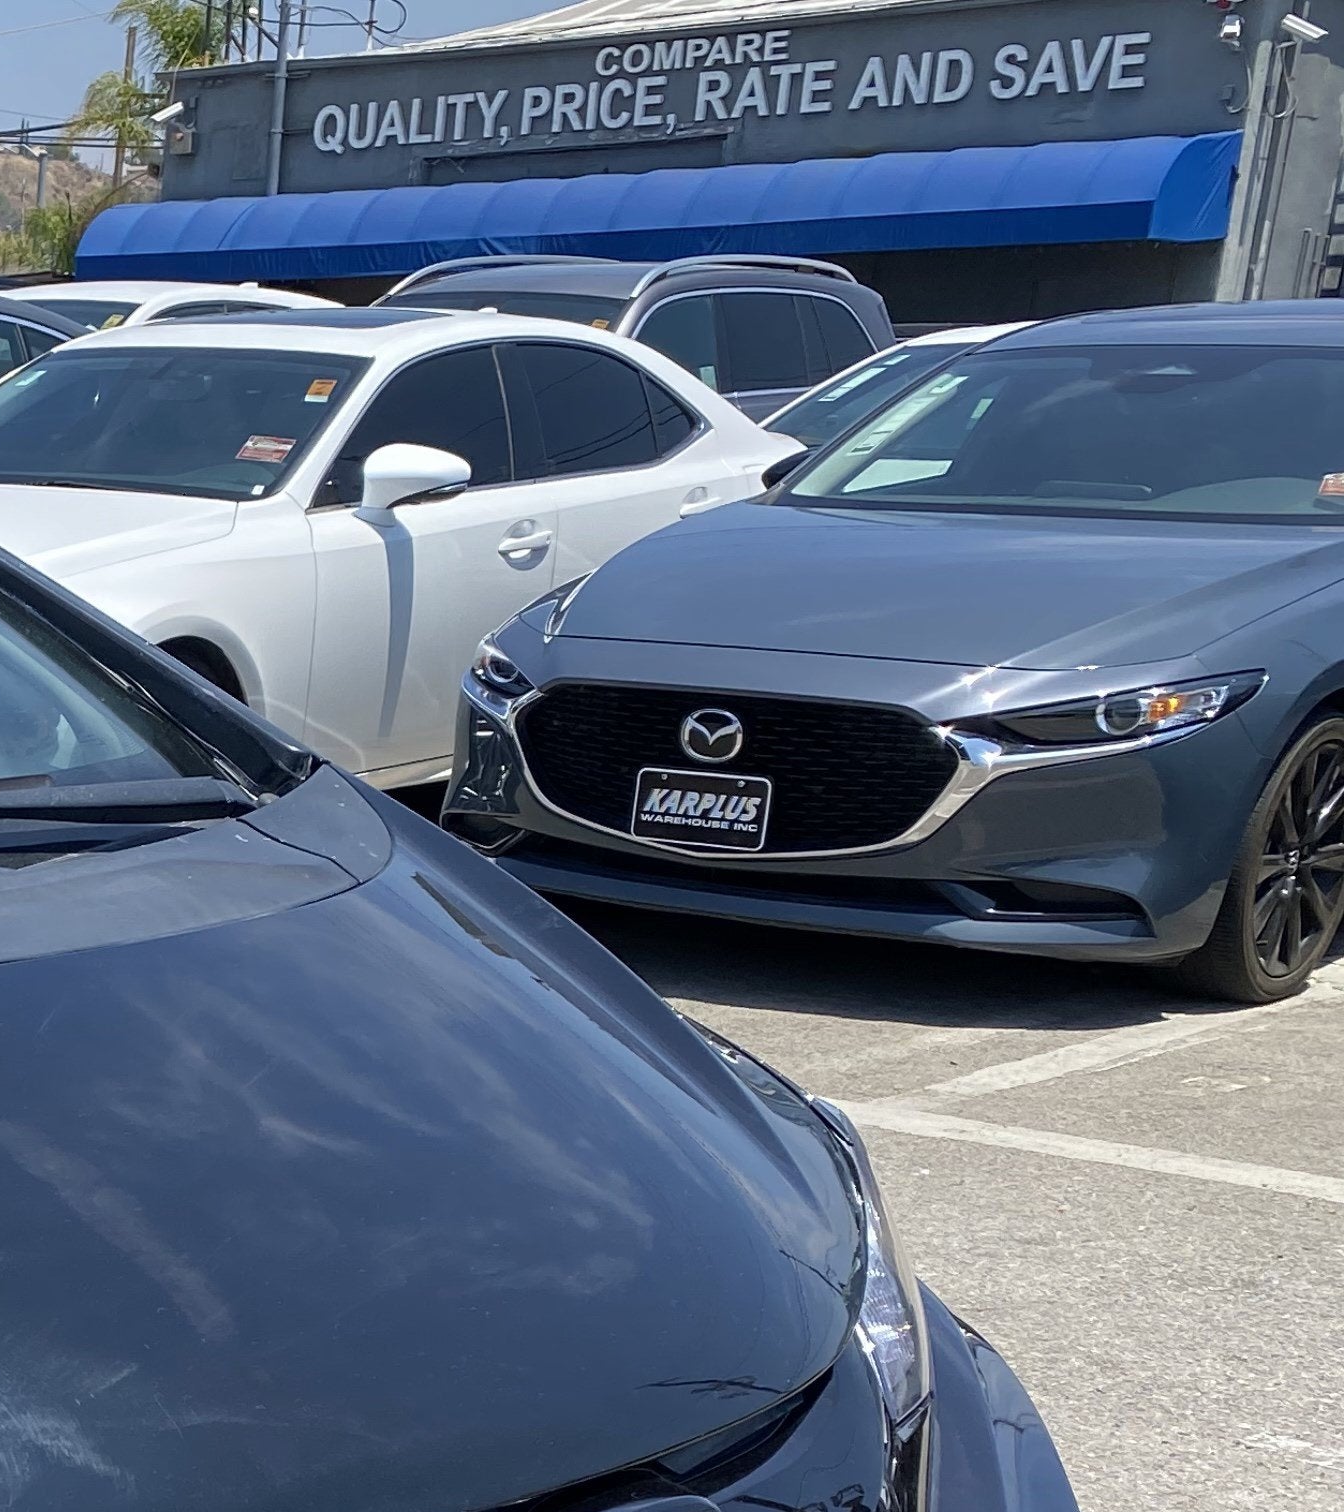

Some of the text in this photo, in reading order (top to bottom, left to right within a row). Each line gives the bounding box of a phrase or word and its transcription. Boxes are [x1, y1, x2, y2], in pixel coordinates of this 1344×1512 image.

[595, 30, 791, 76] COMPARE
[313, 32, 1152, 154] QUALITY, PRICE, RATE AND SAVE
[640, 813, 758, 832] WAREHOUSE INC
[643, 788, 762, 821] KARPLUS
